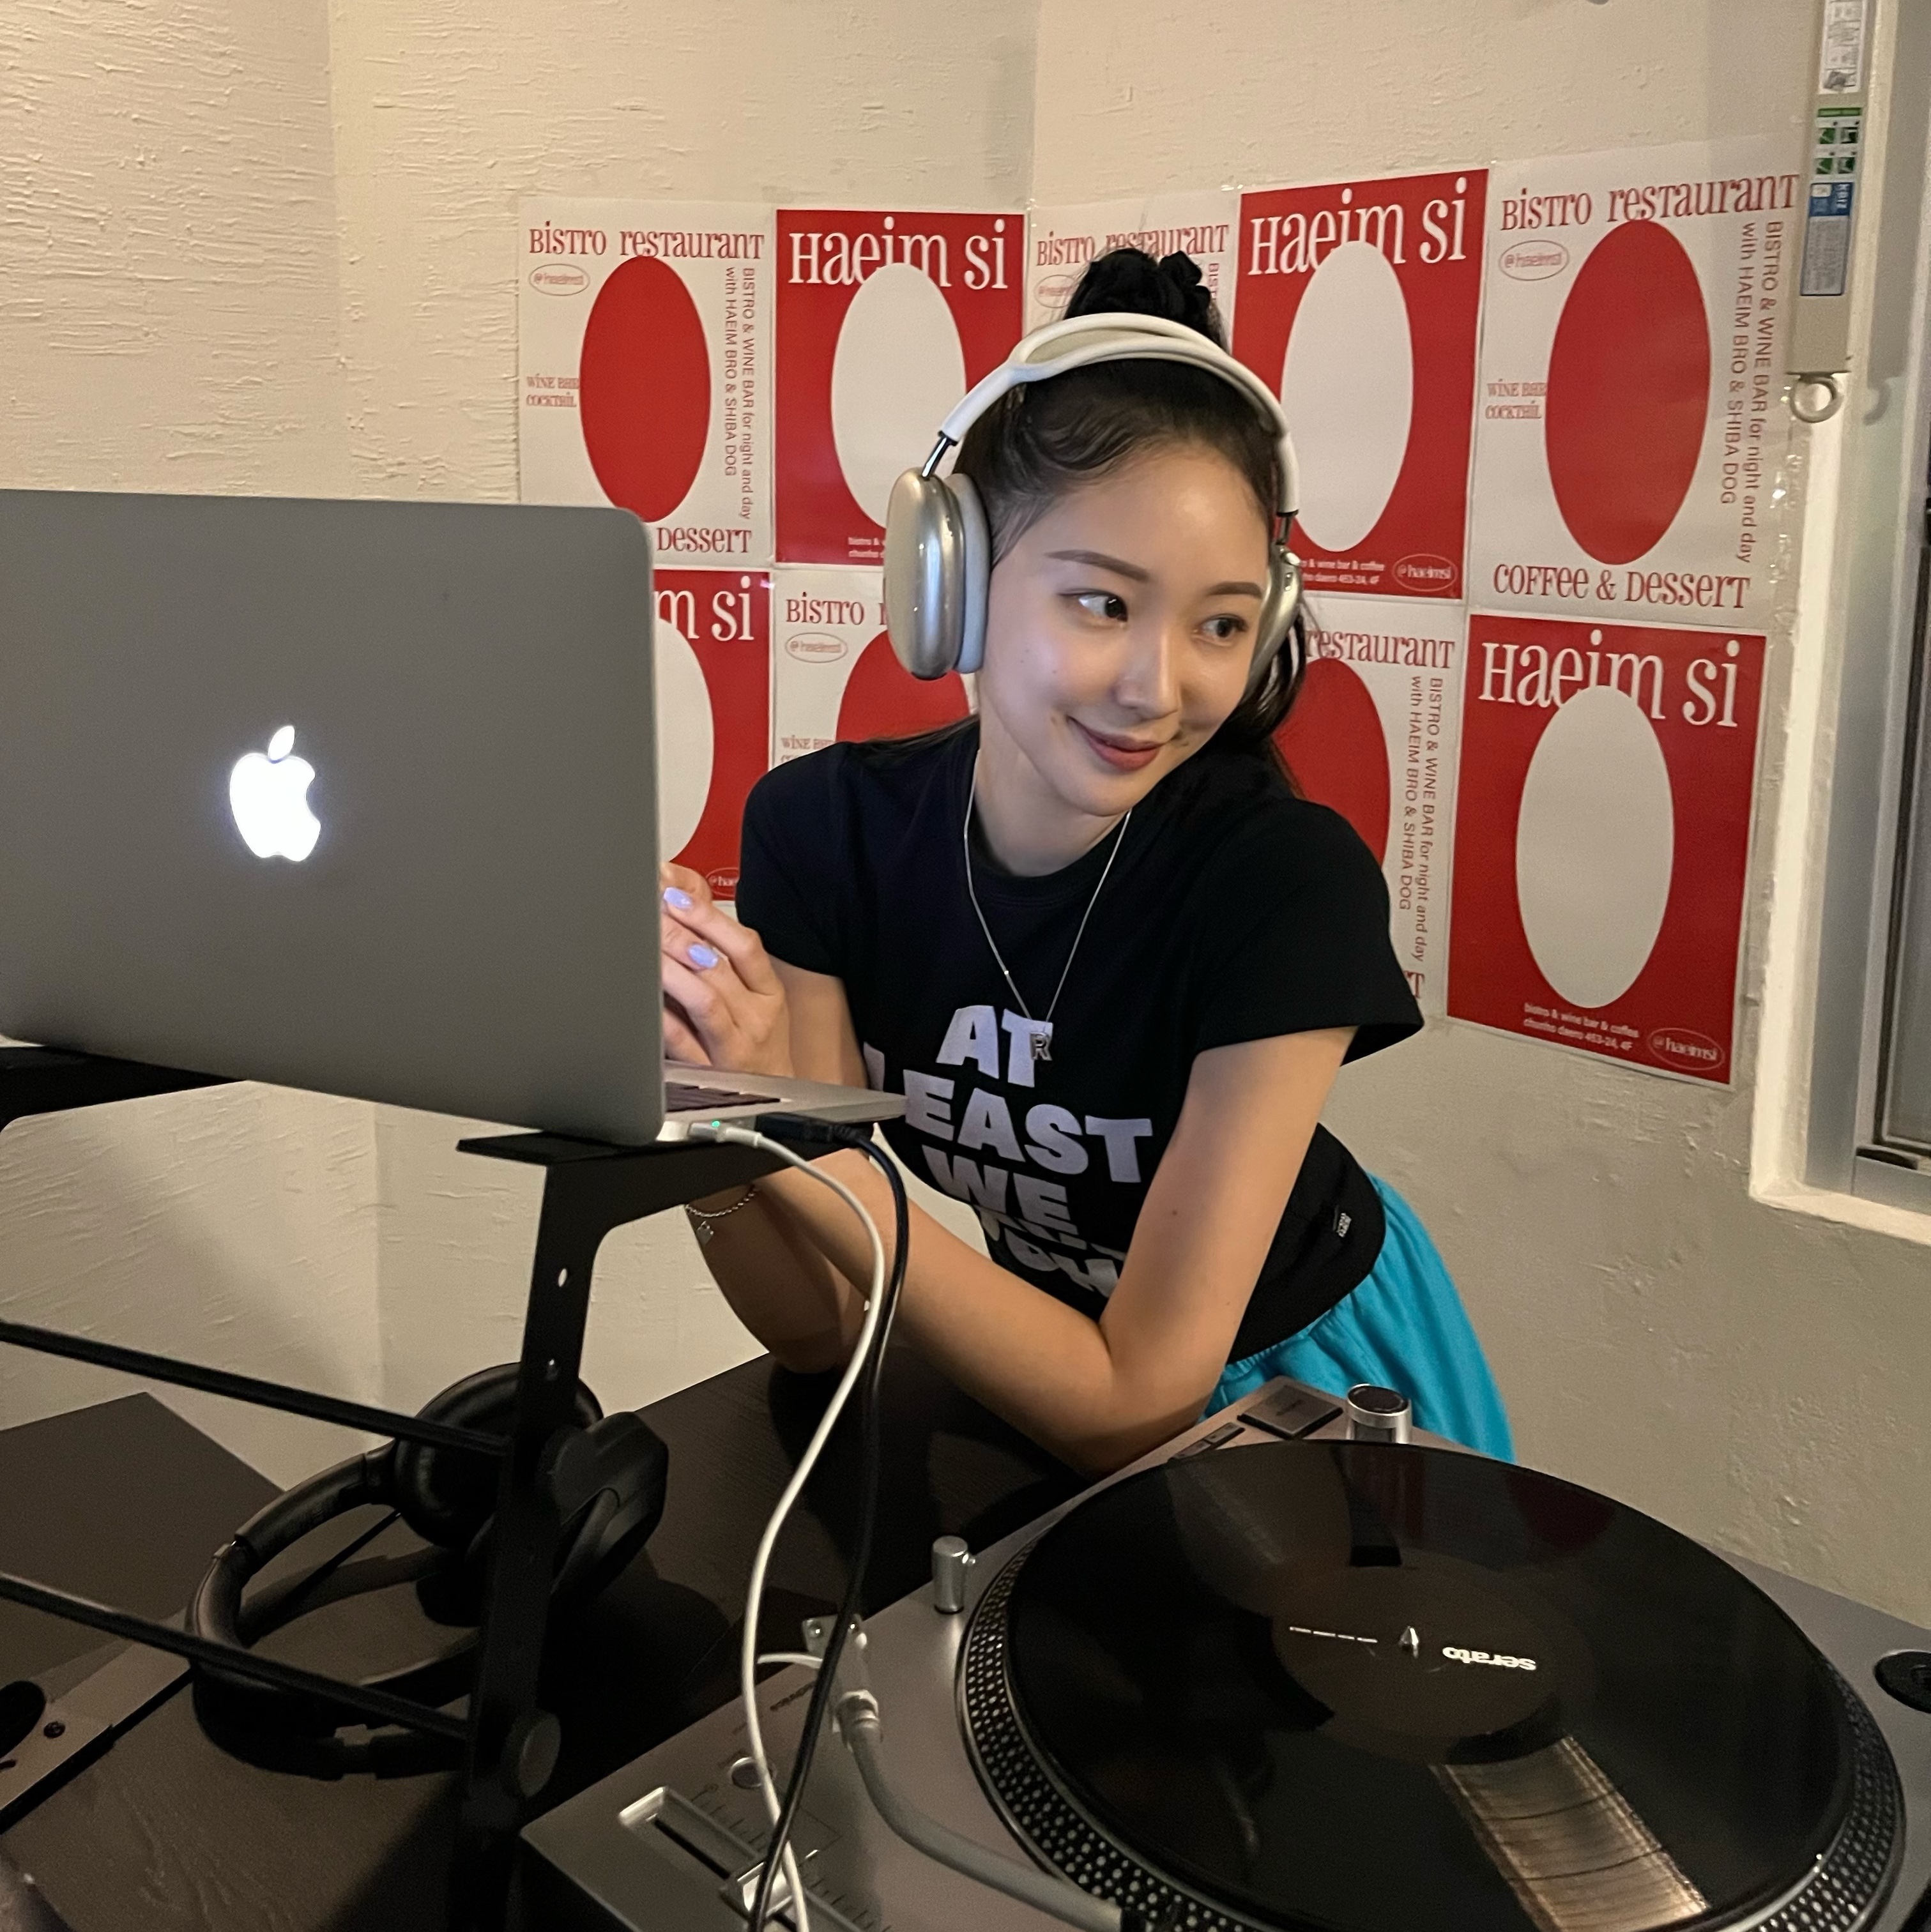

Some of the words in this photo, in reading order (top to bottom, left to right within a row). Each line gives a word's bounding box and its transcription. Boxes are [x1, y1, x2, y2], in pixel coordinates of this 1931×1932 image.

[1419, 177, 1467, 264] si
[964, 218, 1007, 290] si
[1741, 222, 1758, 260] with
[1762, 221, 1783, 291] BISTRO
[725, 267, 737, 294] with
[742, 268, 755, 319] BISTRO
[1734, 267, 1755, 328] HAEIM
[1760, 298, 1777, 310] &
[725, 300, 737, 345] HAEIM
[742, 324, 754, 333] &
[742, 338, 754, 376] WINE
[1731, 335, 1749, 374] BRO
[1754, 317, 1775, 368] WINE
[725, 350, 737, 379] BRO
[725, 383, 737, 393] &
[742, 380, 754, 407] BAR
[1729, 380, 1746, 393] &
[1752, 374, 1769, 411] BAR
[725, 398, 737, 440] SHIBA
[742, 413, 755, 429] for
[1725, 400, 1743, 456] SHIBA
[1749, 418, 1767, 439] for
[725, 445, 737, 476] DOG
[740, 434, 754, 464] night
[742, 469, 754, 493] and
[1720, 462, 1739, 504] DOG
[1743, 447, 1763, 488] night
[738, 497, 754, 519] day
[1742, 495, 1757, 527] and
[1737, 533, 1756, 563] day
[1596, 570, 1616, 600] &
[712, 575, 754, 641] si
[1410, 676, 1423, 707] with
[1682, 639, 1741, 728] si
[1427, 678, 1443, 736] BISTRO
[1408, 711, 1423, 763] HAEIM
[1426, 740, 1439, 752] &
[1405, 768, 1419, 802] BRO
[1423, 757, 1438, 800] WINE
[1404, 806, 1417, 817] &
[1422, 804, 1435, 836] BAR
[1401, 822, 1415, 870] SHIBA
[1419, 840, 1433, 862] for
[1399, 875, 1412, 910] DOG
[1415, 864, 1430, 901] night
[1415, 905, 1428, 933] and
[1410, 936, 1428, 962] day
[936, 1005, 1053, 1088] AT
[1030, 1031, 1053, 1061] R
[922, 1145, 1078, 1235] WE
[1442, 1647, 1536, 1671] serato
